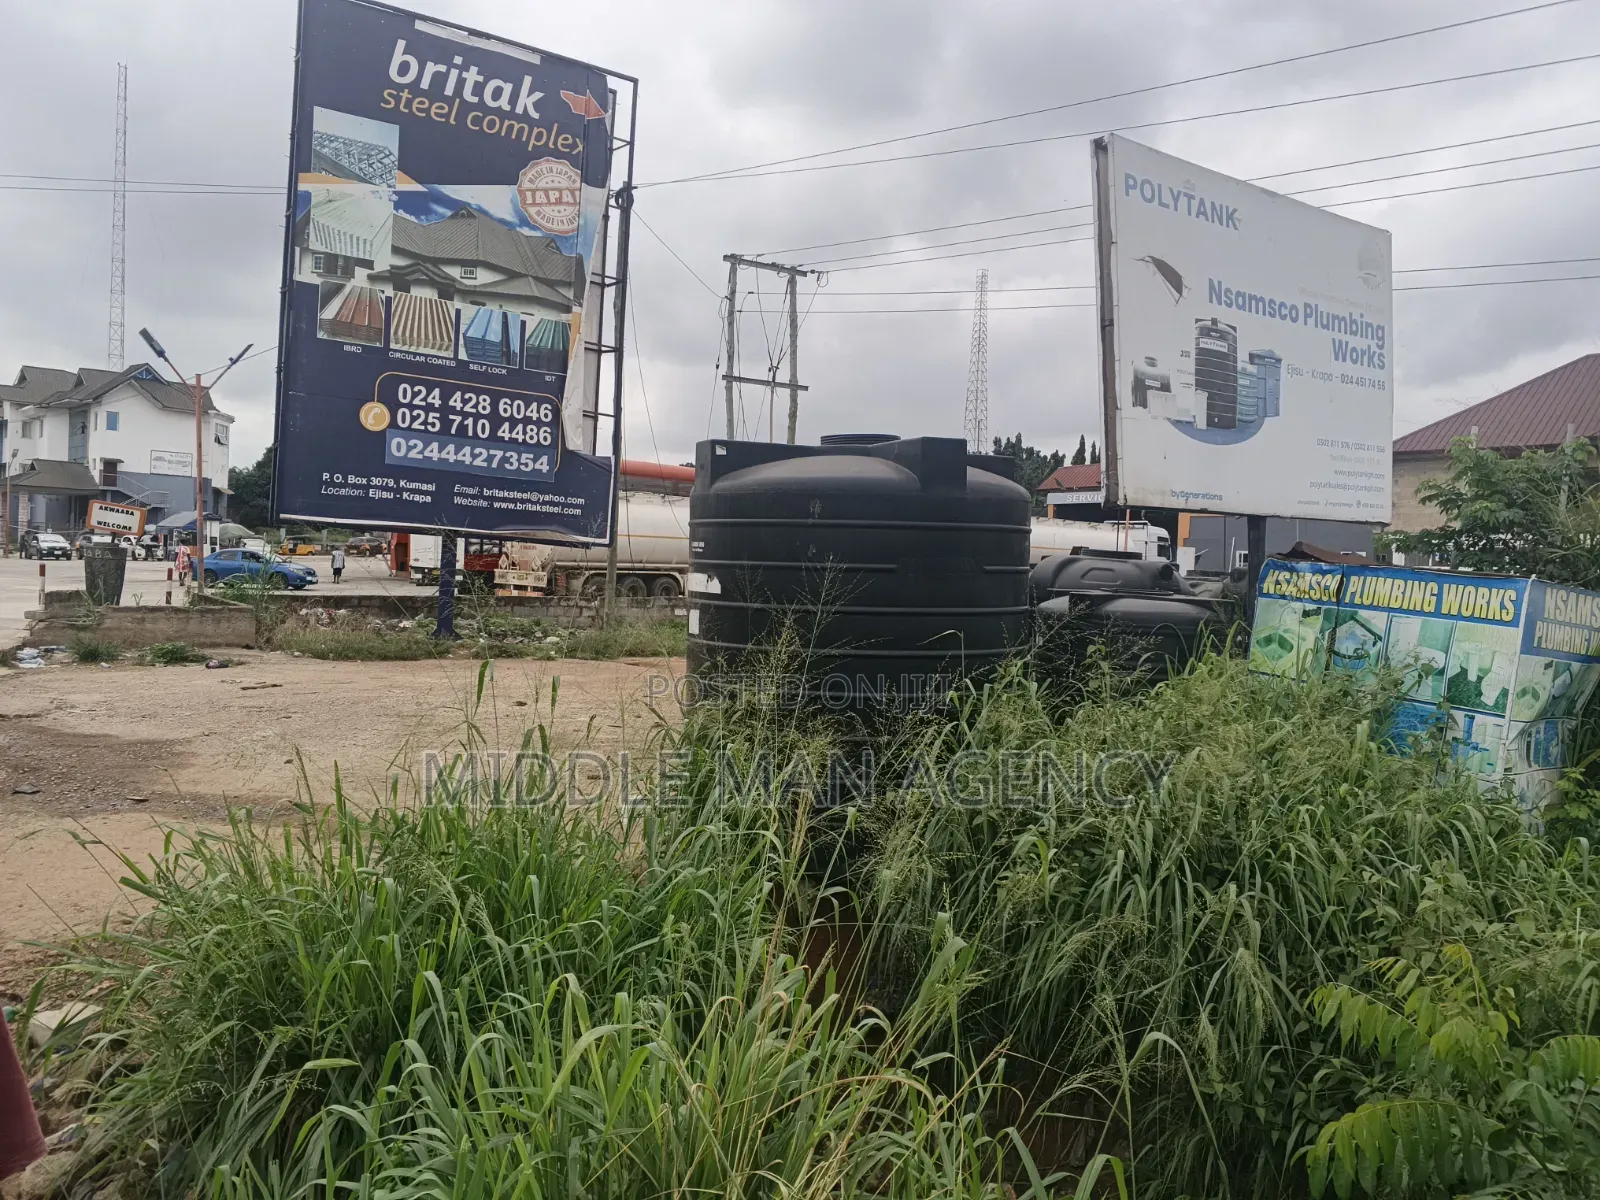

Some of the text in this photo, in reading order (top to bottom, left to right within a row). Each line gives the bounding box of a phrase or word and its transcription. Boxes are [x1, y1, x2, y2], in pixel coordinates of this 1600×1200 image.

[388, 39, 546, 119] britak
[380, 88, 584, 155] steel complex
[528, 166, 578, 186] MADE IN JAPAN
[1124, 172, 1239, 231] POLYTANK
[534, 209, 554, 226] MADE
[1208, 278, 1300, 324] Nsamsco
[1304, 302, 1386, 350] Plumbing
[388, 351, 456, 367] CIRCULAR COATED
[1332, 338, 1386, 370] Works
[469, 364, 508, 376] SELF LOCK
[1287, 363, 1304, 378] Ejisu
[1341, 373, 1354, 386] 024
[1378, 380, 1386, 391] 56
[398, 383, 552, 422] 024 428 6046
[396, 408, 552, 446] 025 710 4486
[390, 438, 550, 474] 0244427354
[321, 485, 366, 497] Location:
[368, 488, 394, 502] Ejisu
[402, 492, 432, 504] Krapa
[322, 472, 436, 492] P. O. Box 3079, Kumasi
[454, 484, 585, 506] Email: britaksteel@yahoo.com
[98, 505, 134, 516] AKWAABA
[454, 496, 582, 516] Website: www.britaksteel.com
[96, 520, 132, 532] WELCOME
[1344, 576, 1438, 613] PLUMBING
[1440, 583, 1516, 622] WORKS
[1534, 620, 1590, 655] PLUMBING
